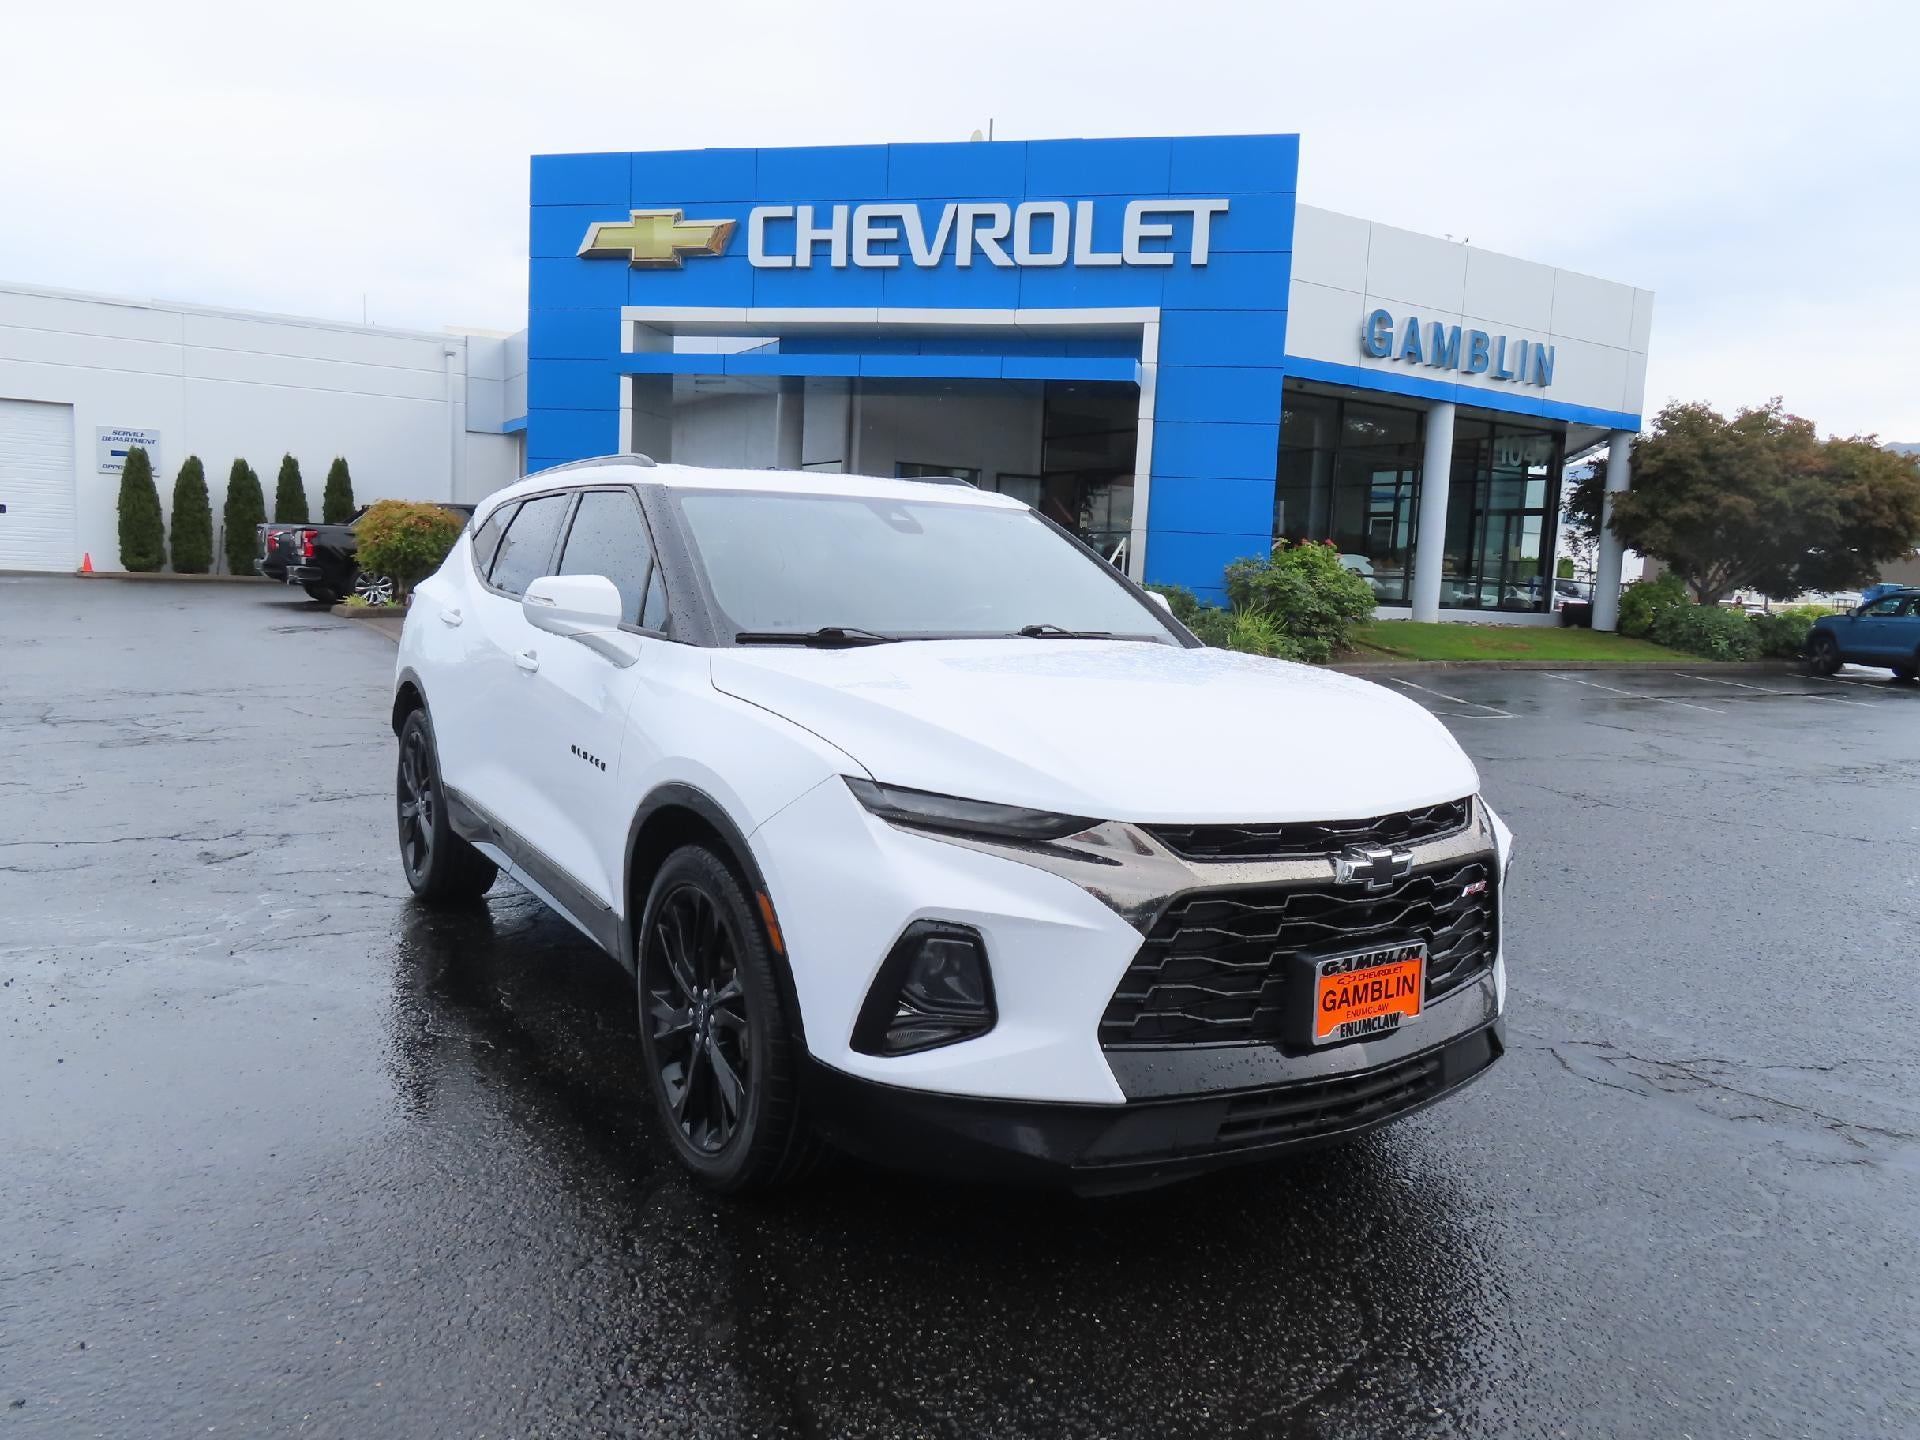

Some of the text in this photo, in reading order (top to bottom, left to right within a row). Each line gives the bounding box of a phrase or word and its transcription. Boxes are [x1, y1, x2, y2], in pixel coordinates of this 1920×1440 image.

[748, 199, 1230, 268] CHEVROLET
[1363, 308, 1555, 387] GAMBLIN
[102, 436, 156, 444] DEPARTMENT
[571, 744, 606, 772] BLAZER
[1321, 944, 1422, 976] GAMBLIN
[1358, 966, 1404, 981] CHEVROLET
[1321, 973, 1416, 1012] GAMBLIN
[1340, 1012, 1401, 1038] ENUMCLAW
[1346, 1003, 1389, 1019] ENUMCLAW
